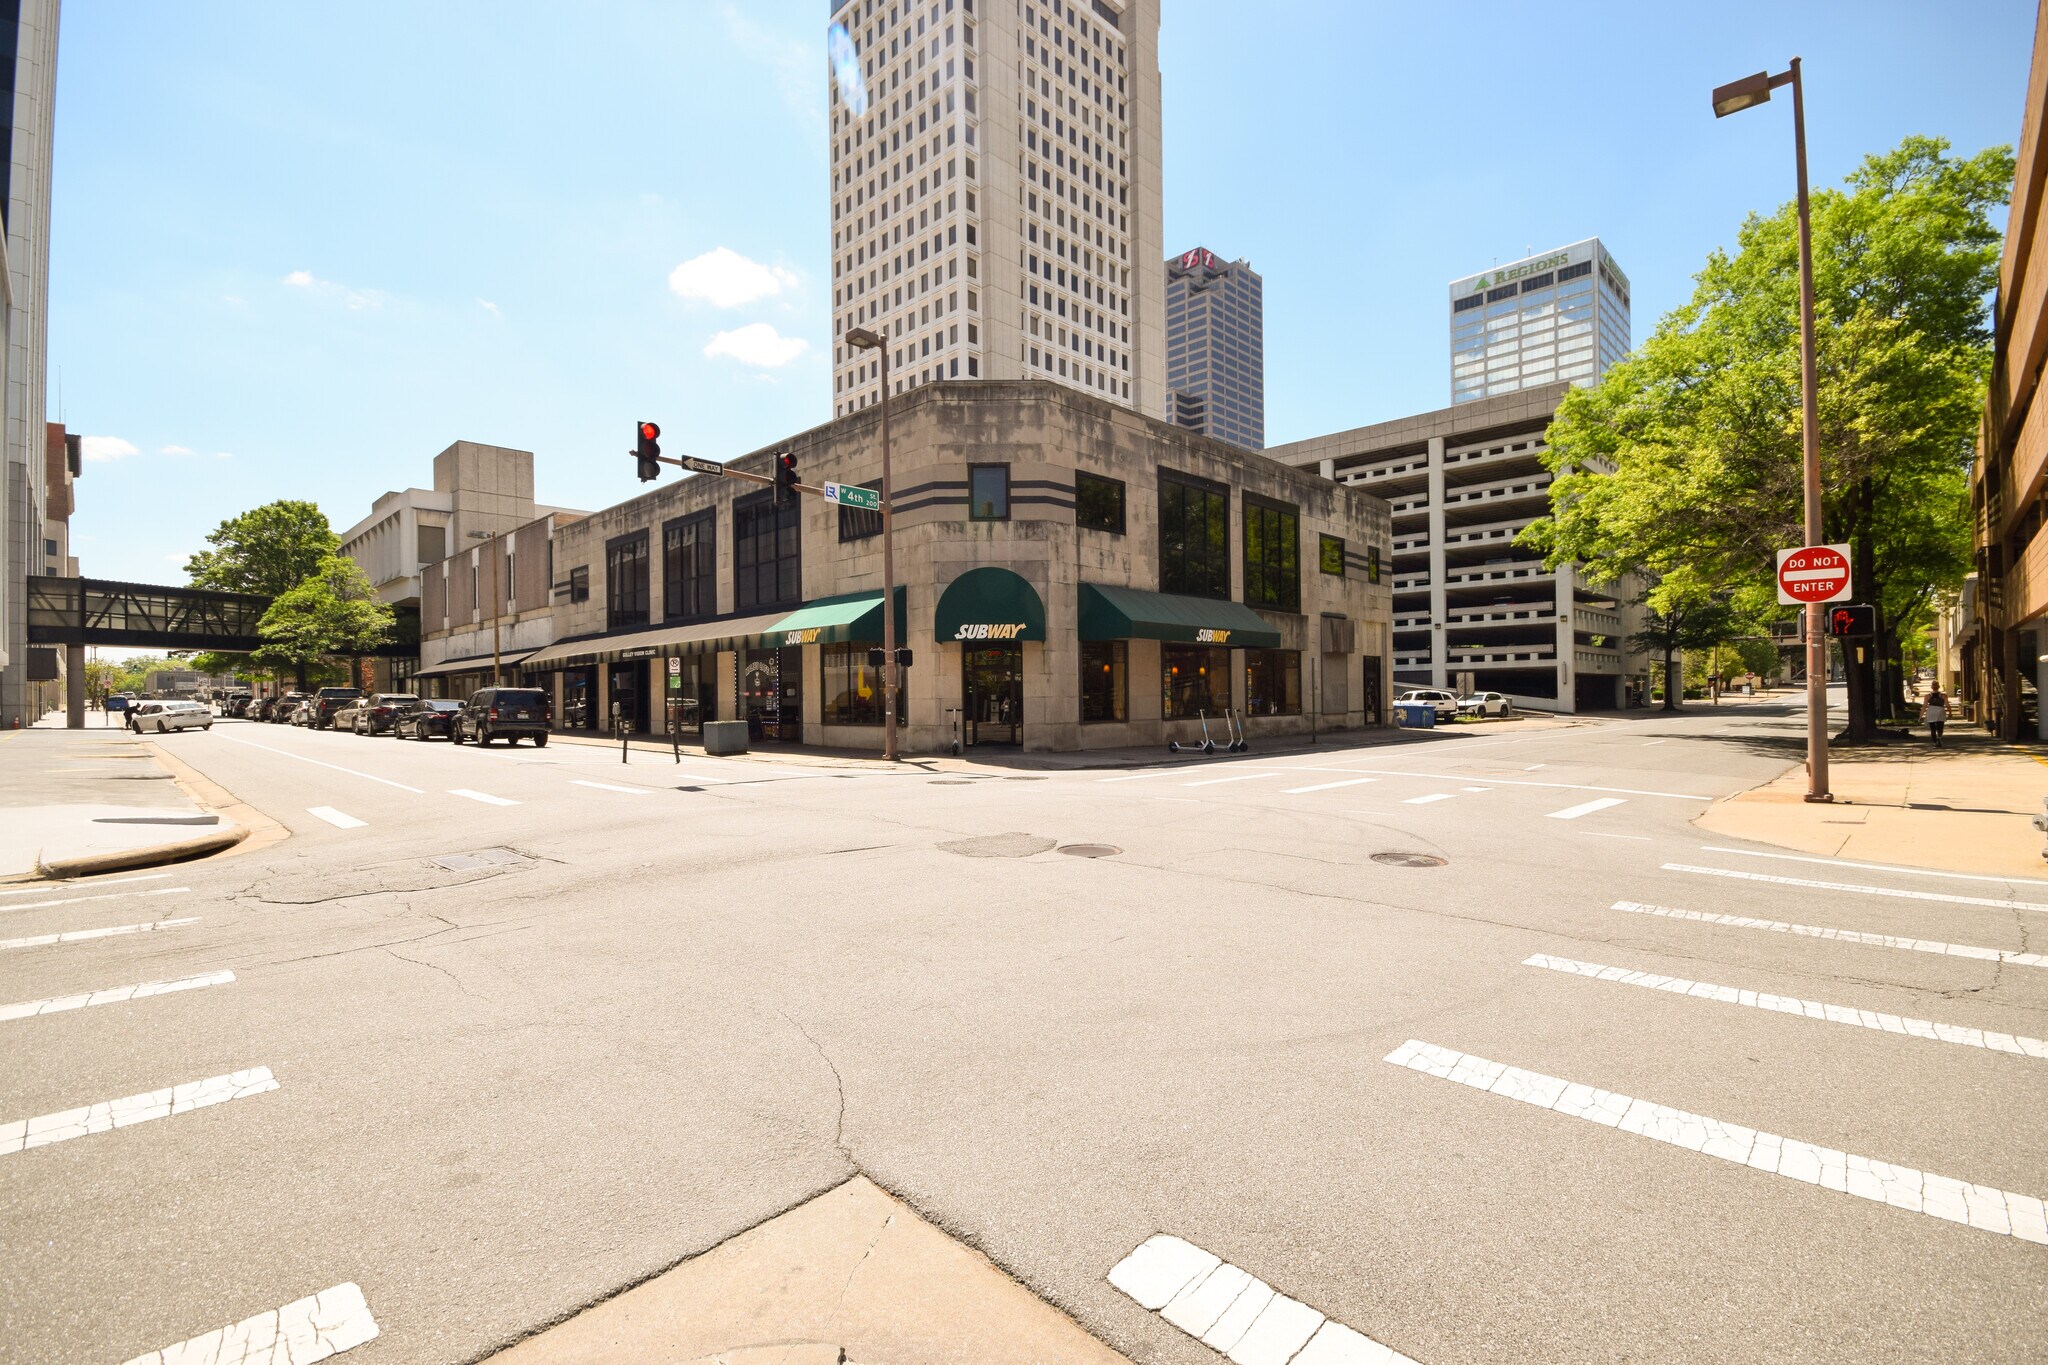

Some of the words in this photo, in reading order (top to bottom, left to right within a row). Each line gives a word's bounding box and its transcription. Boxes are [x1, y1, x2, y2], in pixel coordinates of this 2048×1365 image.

[1493, 252, 1569, 285] REGIONS
[693, 461, 706, 470] ONE
[706, 464, 719, 472] WAY
[847, 491, 863, 503] 4th
[866, 499, 878, 507] 200
[1789, 558, 1806, 569] DO
[1813, 556, 1840, 567] NOT
[1793, 581, 1834, 593] ENTER
[785, 628, 821, 645] SUBWAY
[954, 622, 1027, 640] SUBWAY
[1196, 628, 1231, 643] SUBWAY
